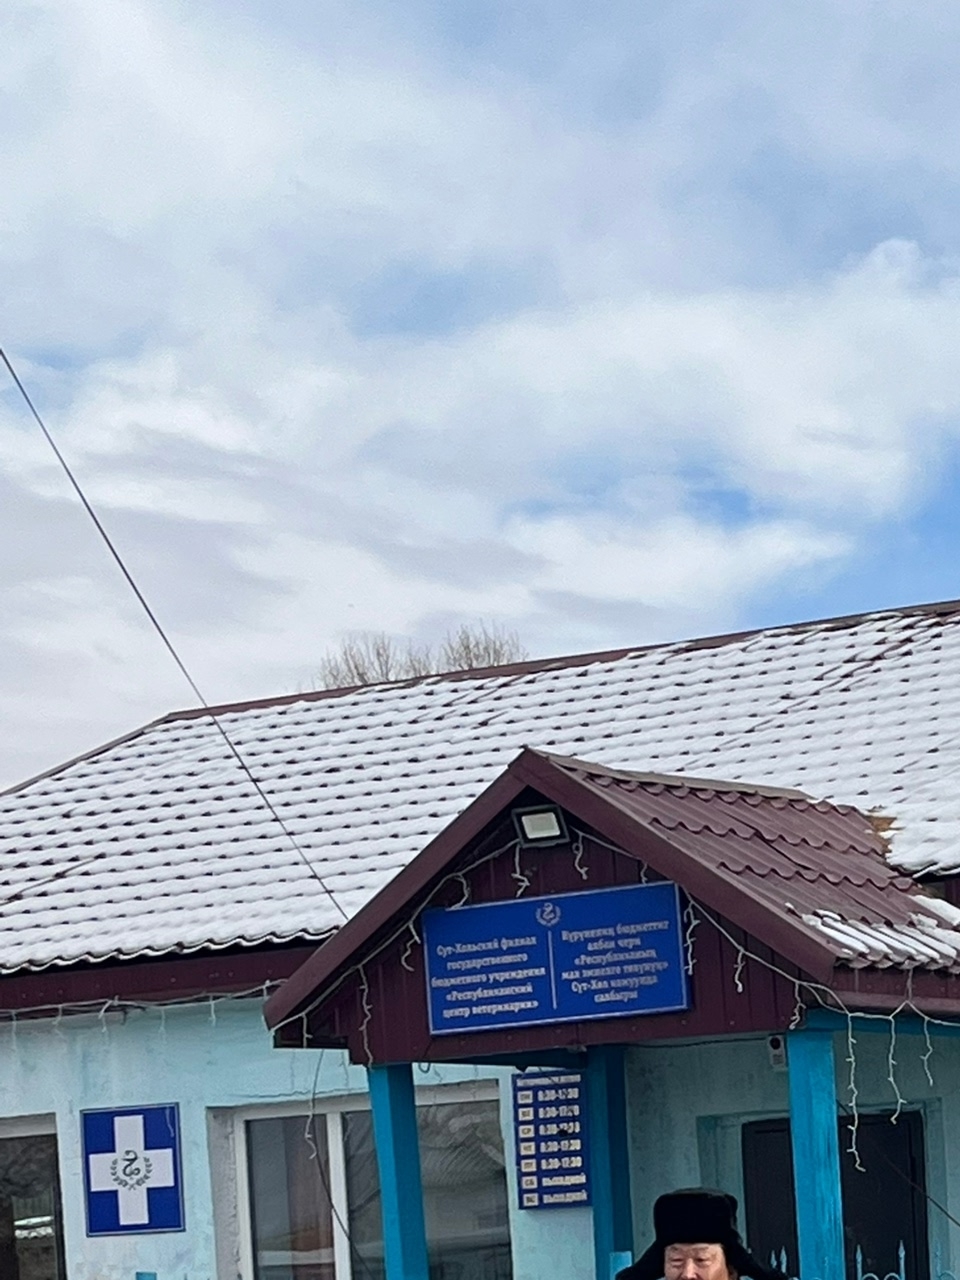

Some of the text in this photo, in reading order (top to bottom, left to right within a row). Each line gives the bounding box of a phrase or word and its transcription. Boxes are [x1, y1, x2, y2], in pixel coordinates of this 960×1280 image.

[438, 937, 537, 958] Сут-Хольский филиал
[448, 954, 528, 971] государственного
[432, 968, 546, 988] бюджетного учреждения
[444, 1008, 470, 1018] центр
